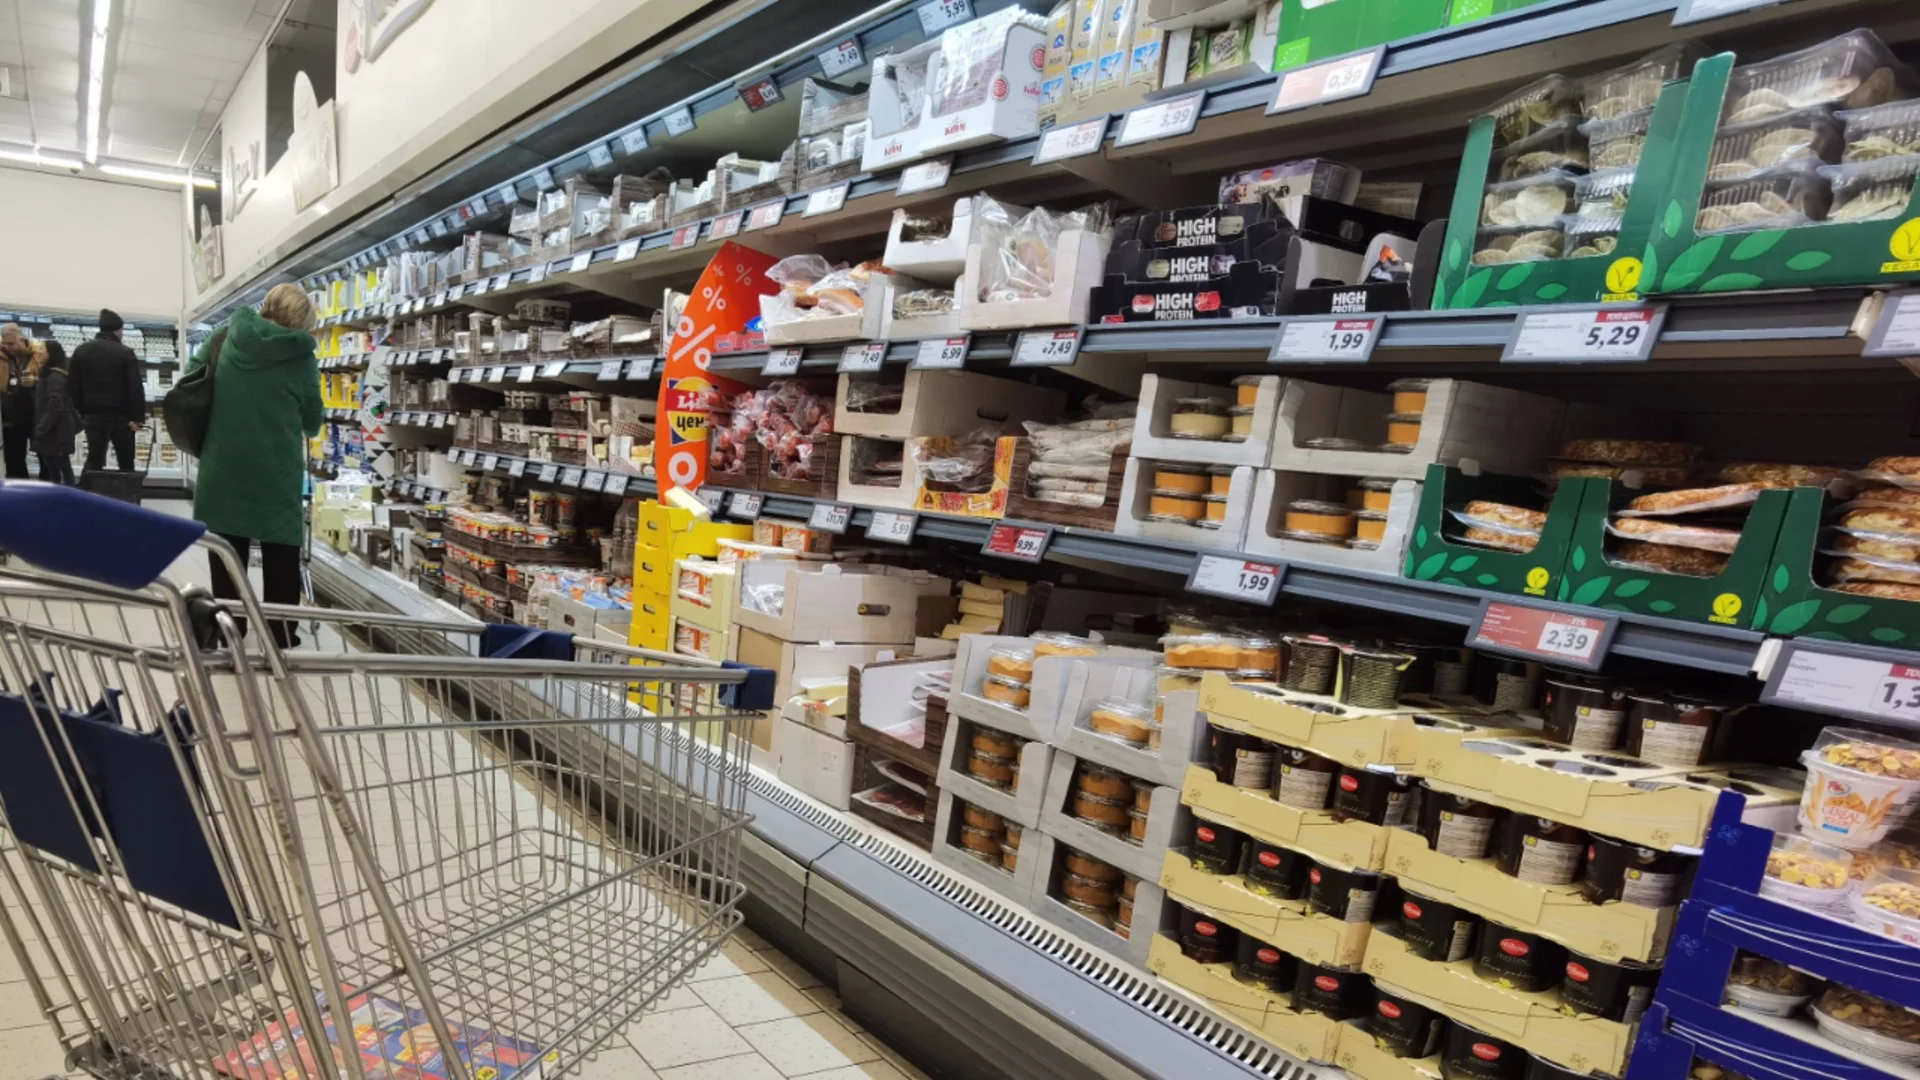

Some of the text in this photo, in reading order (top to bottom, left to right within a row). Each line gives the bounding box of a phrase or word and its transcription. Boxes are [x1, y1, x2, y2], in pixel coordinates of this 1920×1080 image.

[945, 0, 965, 18] 5,99
[1328, 69, 1362, 89] 0,99
[1159, 108, 1190, 128] 3,99
[1177, 217, 1216, 236] HIGH
[1176, 234, 1216, 247] PROTEIN
[1170, 256, 1209, 273] HIGH
[1155, 292, 1193, 310] HIGH
[1332, 291, 1367, 306] HIGH
[1602, 293, 1637, 302] VEGAN
[1155, 308, 1194, 320] PROTEIN
[1331, 303, 1366, 313] PROTEIN
[1328, 333, 1364, 352] 1,99
[1584, 325, 1641, 349] 5,29
[941, 347, 961, 360] 6,99
[1047, 341, 1072, 355] 7,49
[1238, 573, 1269, 591] 1,99
[1545, 629, 1588, 650] 2,39
